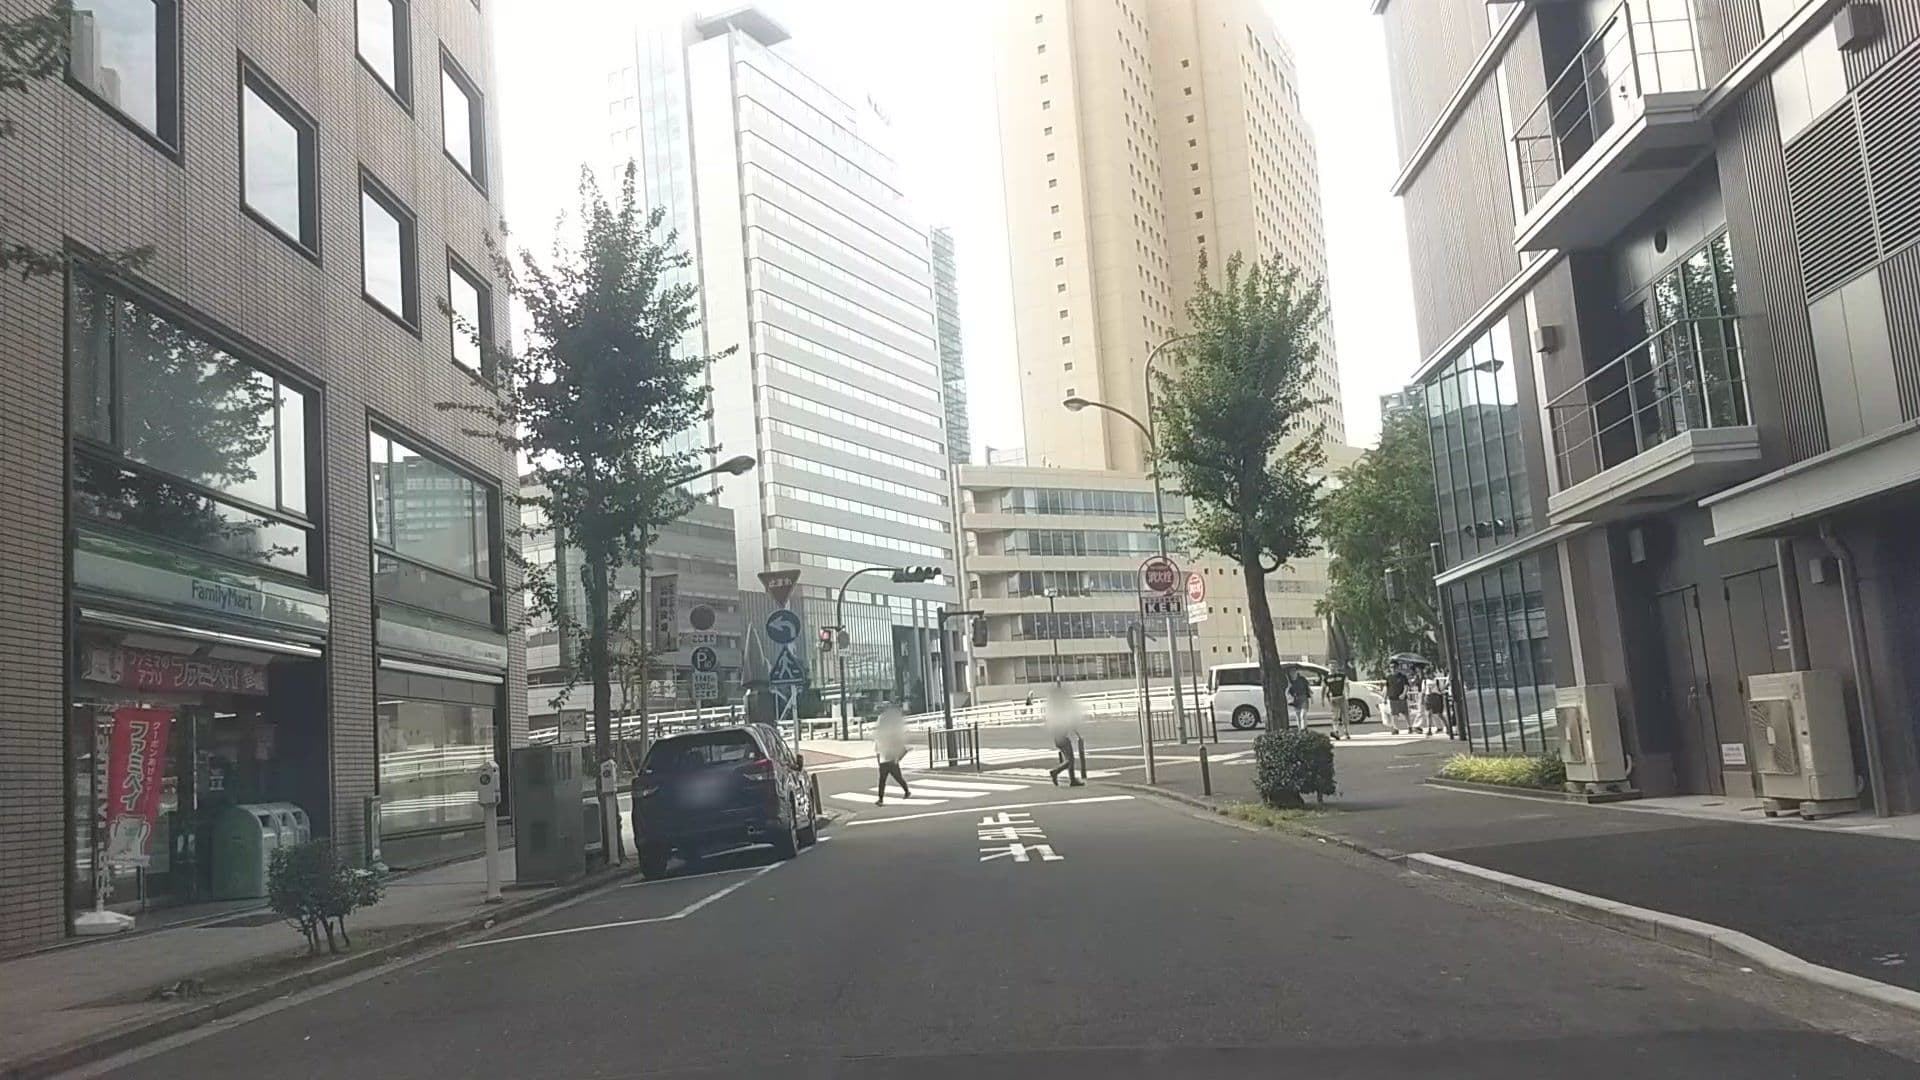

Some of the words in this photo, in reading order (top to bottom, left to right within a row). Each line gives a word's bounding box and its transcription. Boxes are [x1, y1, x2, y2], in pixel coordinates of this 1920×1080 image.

[191, 579, 252, 610] FamilyMart
[119, 720, 149, 812] ファミペイ
[977, 812, 1064, 862] 止まれ
